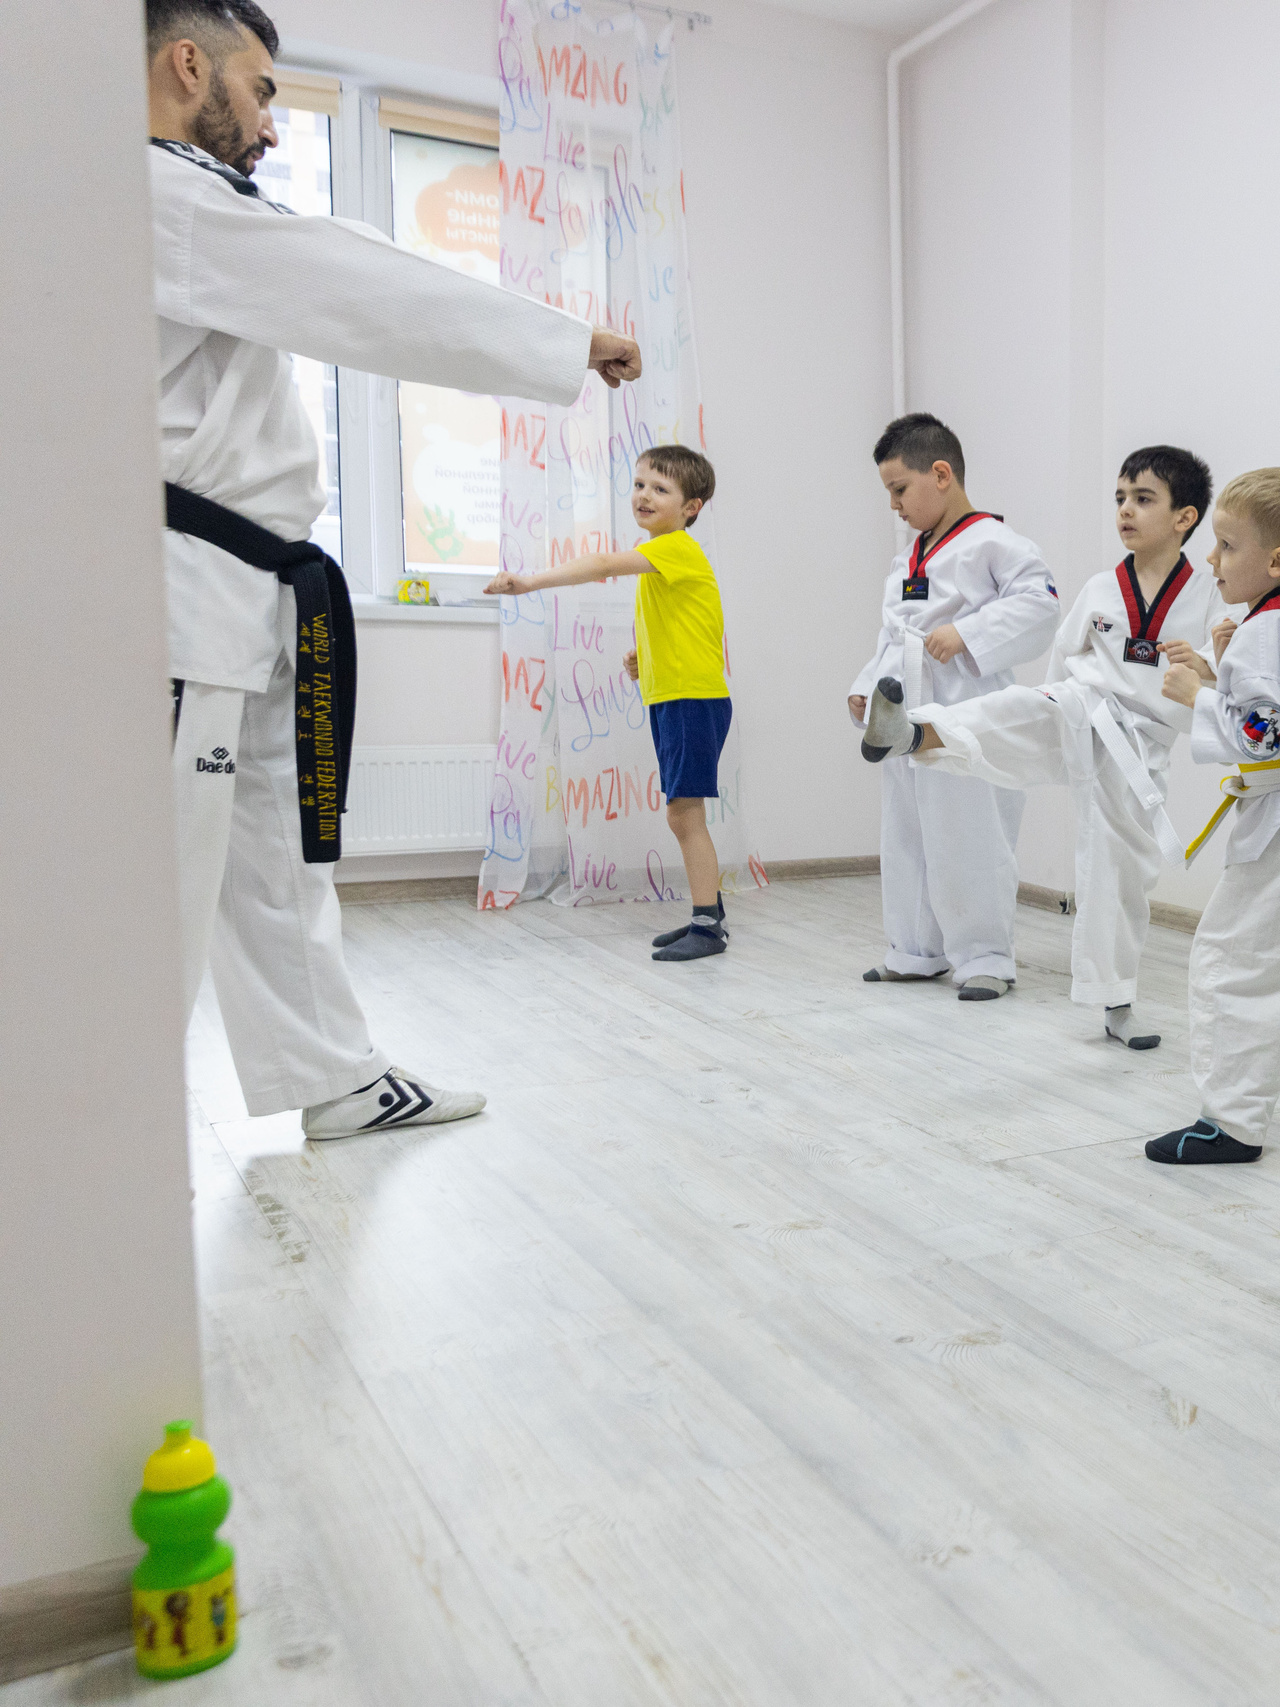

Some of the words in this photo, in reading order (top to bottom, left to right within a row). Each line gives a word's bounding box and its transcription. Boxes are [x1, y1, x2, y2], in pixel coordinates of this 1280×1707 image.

[312, 613, 330, 664] WORLD
[553, 594, 604, 654] Live
[313, 672, 334, 756] TAEKWONDO
[316, 760, 337, 841] FEDERATION
[567, 834, 618, 891] Live
